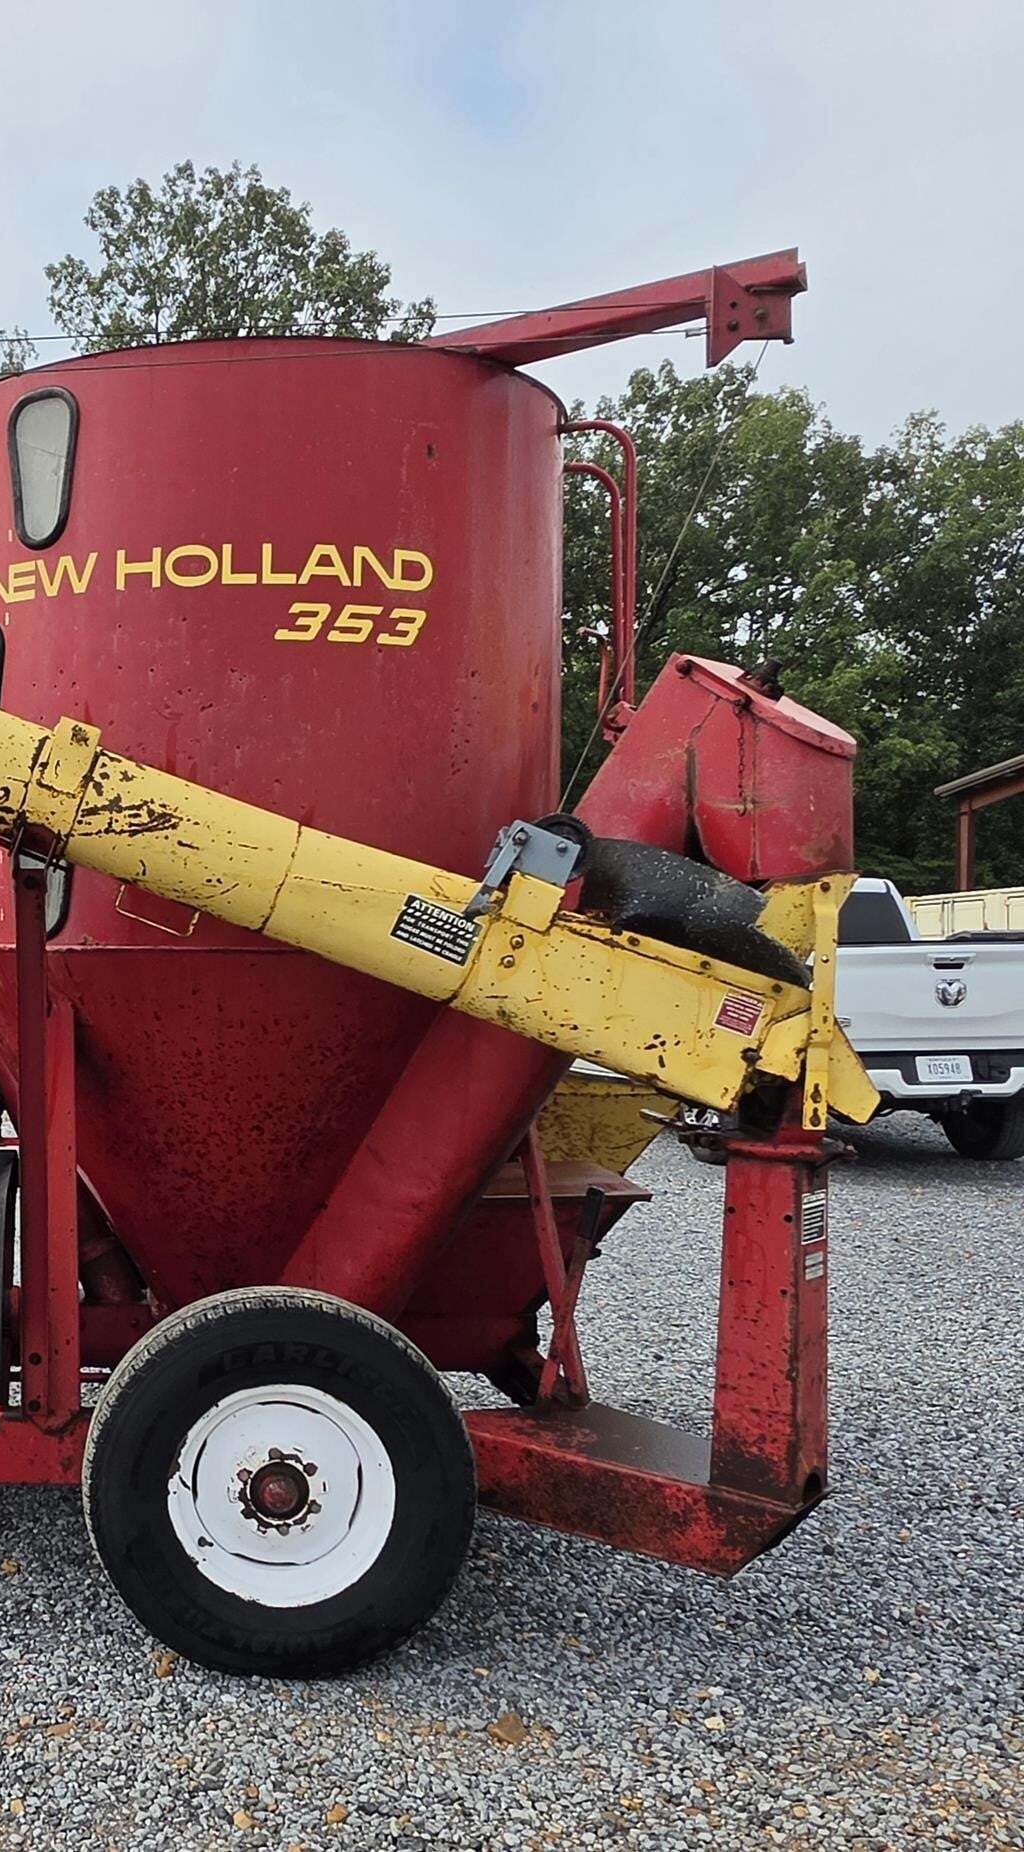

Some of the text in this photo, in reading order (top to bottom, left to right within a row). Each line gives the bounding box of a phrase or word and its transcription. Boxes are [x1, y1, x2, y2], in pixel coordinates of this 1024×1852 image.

[116, 543, 434, 592] HOLLAND
[274, 602, 427, 646] 353
[399, 923, 420, 934] AUGER
[403, 915, 415, 923] FOR
[418, 921, 453, 939] TRANSPORT
[410, 900, 475, 932] ATTENTION
